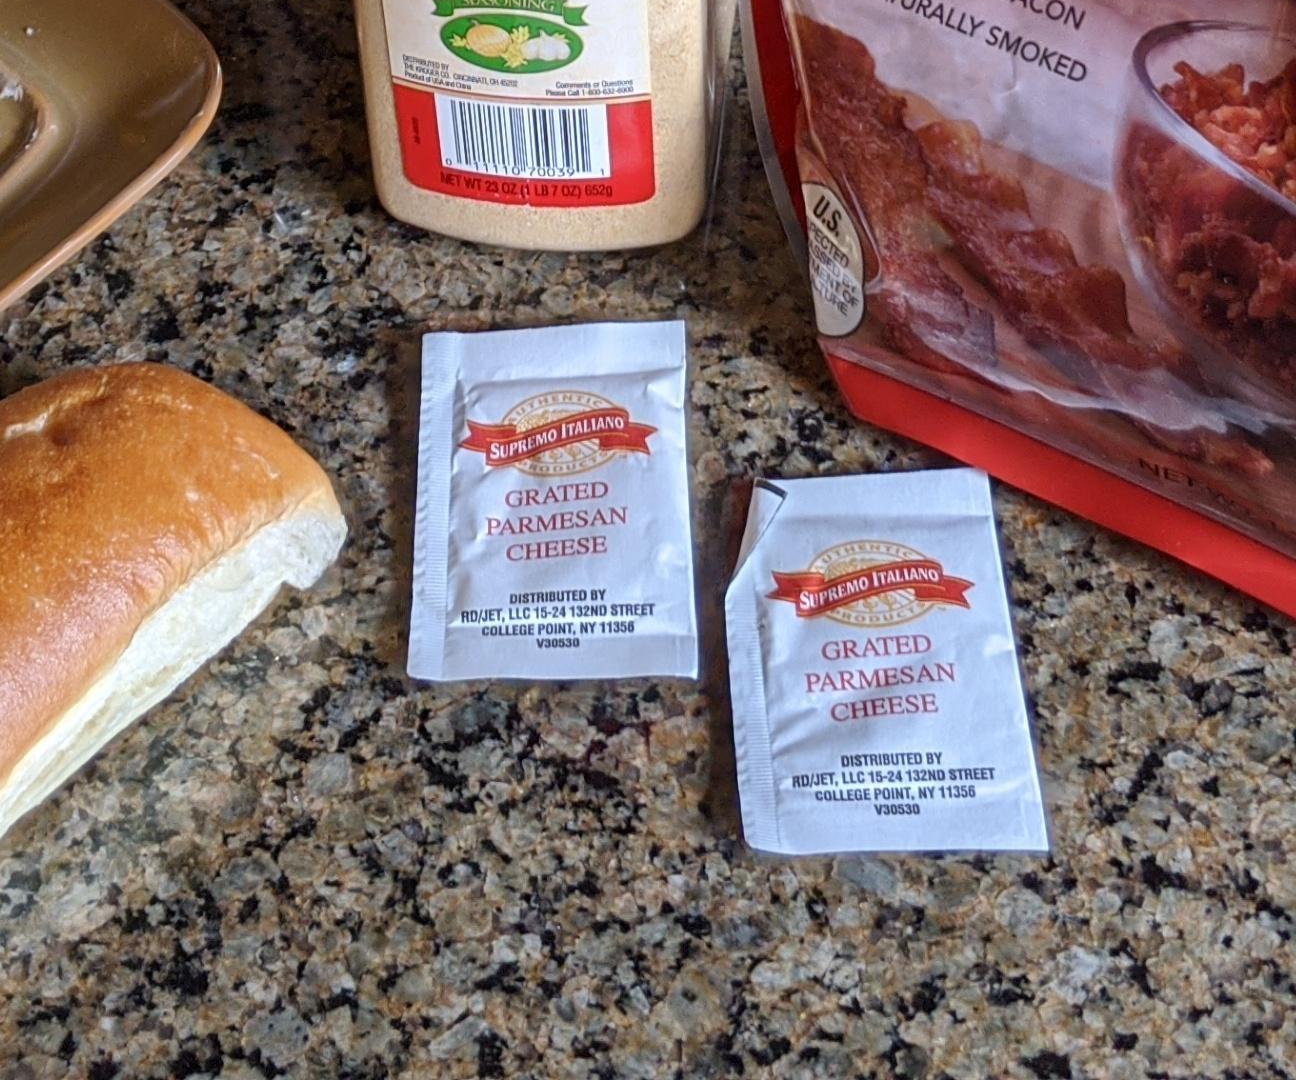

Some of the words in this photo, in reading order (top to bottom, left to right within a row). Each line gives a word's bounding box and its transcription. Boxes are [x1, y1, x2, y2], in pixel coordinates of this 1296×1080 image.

[985, 25, 1088, 82] SMOKED
[445, 158, 452, 166] 0
[474, 162, 521, 176] 11110
[528, 166, 575, 178] 70039
[440, 172, 461, 185] NET
[464, 177, 482, 191] WT
[485, 181, 499, 193] 23
[503, 183, 517, 194] OZ
[535, 184, 549, 196] LB
[552, 185, 559, 196] 7
[562, 185, 581, 199] OZ)
[585, 184, 613, 198] 652g
[813, 195, 842, 237] U.S.
[489, 428, 557, 460] SUPREMO
[561, 416, 625, 439] ITALIANO
[505, 481, 609, 509] GRATED
[487, 506, 628, 537] PARMESAN
[506, 536, 608, 562] CHEESE
[509, 589, 587, 604] DISTRIBUTED
[590, 589, 606, 601] BY
[799, 576, 869, 610] SUPREMO
[872, 566, 940, 588] ITALIANO
[460, 608, 506, 624] RD/JET,
[509, 607, 531, 620] LLC
[535, 605, 566, 619] 15-24
[571, 605, 607, 618] 132ND
[610, 603, 656, 617] STREET
[481, 624, 535, 637] COLLEGE
[538, 622, 577, 636] POINT,
[580, 621, 596, 634] NY
[600, 620, 635, 634] 11356
[536, 638, 580, 649] V30530
[821, 633, 932, 661] GRATED
[805, 662, 956, 694] PARMESAN
[830, 693, 940, 722] CHEESE
[840, 752, 923, 768] DISTRIBUTED
[925, 752, 942, 765] BY
[792, 772, 839, 788] RD/JET,
[841, 771, 865, 785] LLC
[868, 770, 903, 783] 15-24
[905, 768, 946, 782] 132ND
[948, 767, 996, 781] STREET
[815, 788, 872, 802] COLLEGE
[874, 786, 916, 801] POINT,
[918, 786, 936, 799] NY
[939, 785, 976, 798] 11356
[874, 803, 921, 816] V30530
